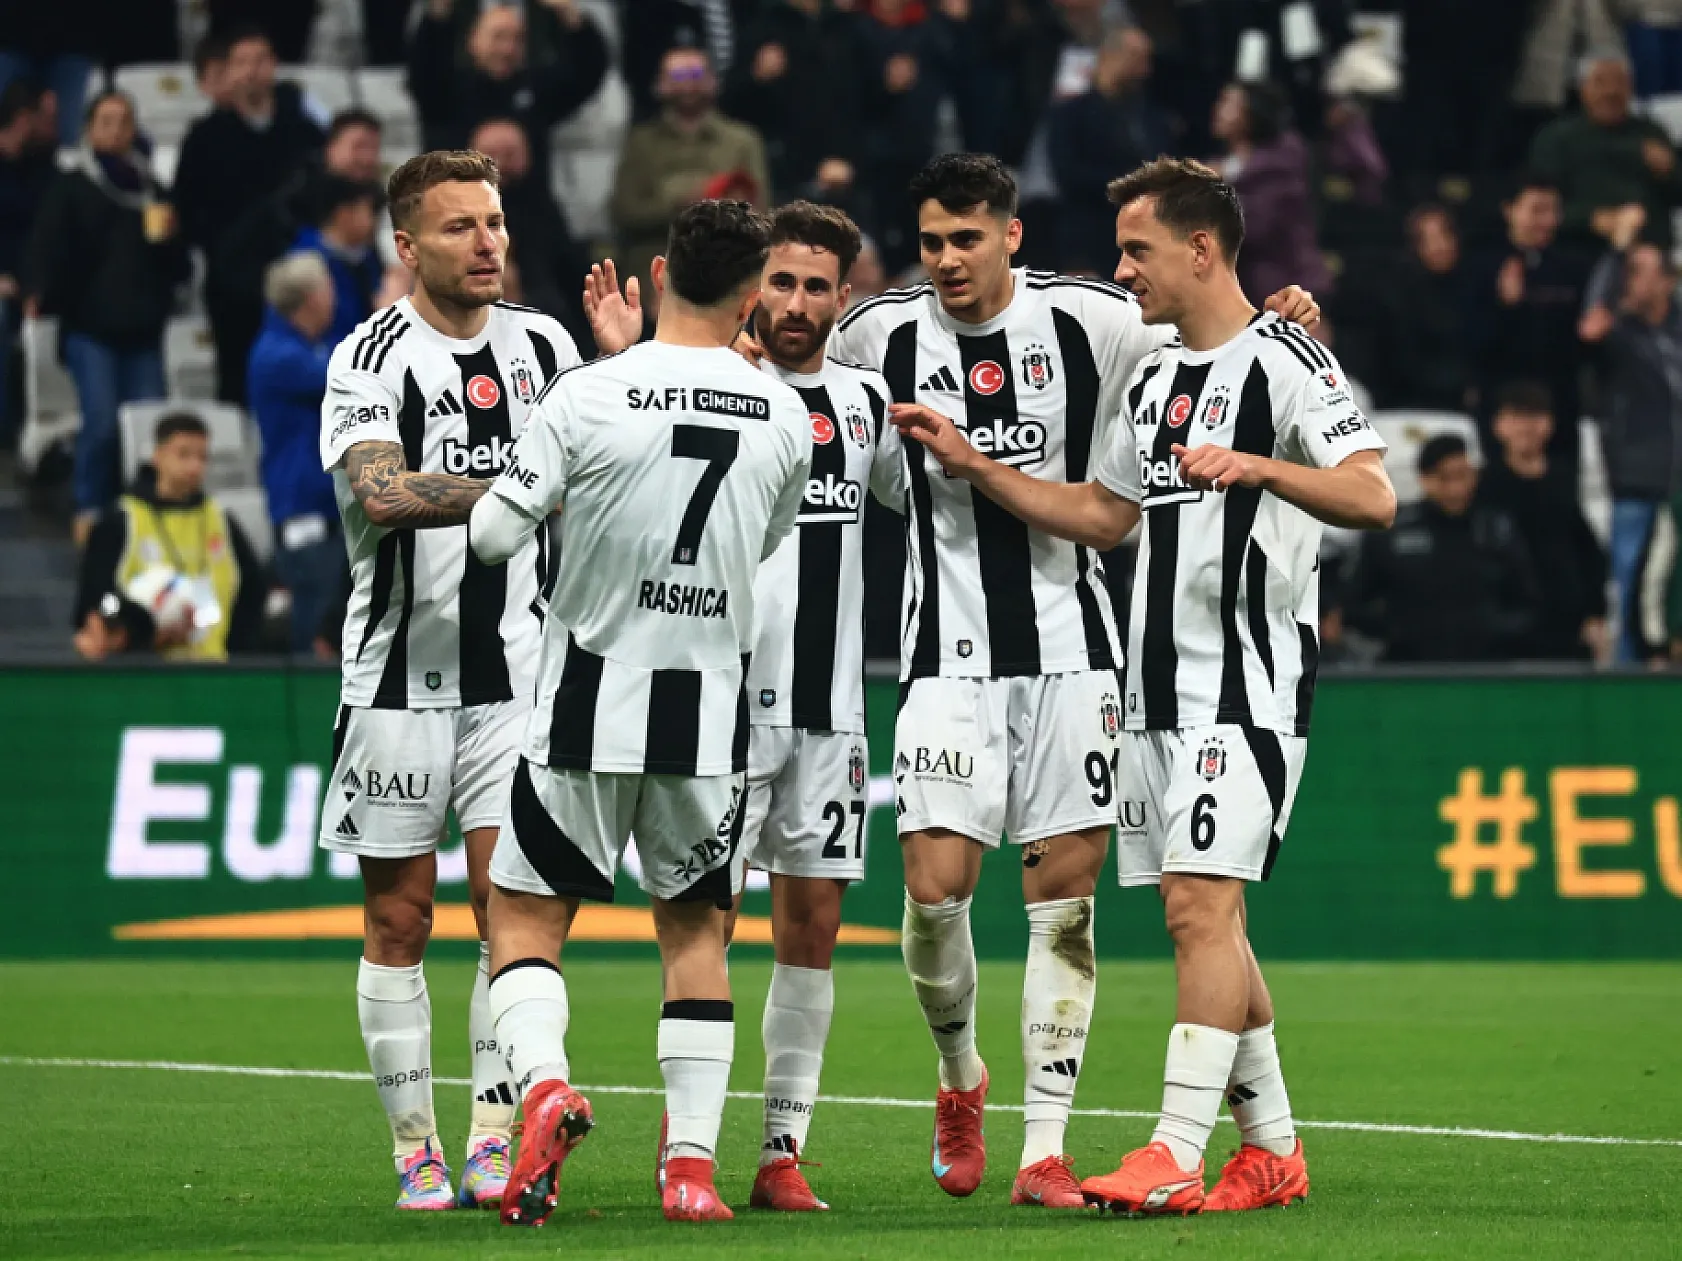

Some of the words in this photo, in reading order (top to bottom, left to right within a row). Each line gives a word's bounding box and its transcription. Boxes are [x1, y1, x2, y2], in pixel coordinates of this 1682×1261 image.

[953, 417, 1046, 453] eko
[443, 436, 515, 476] bek
[1139, 450, 1190, 489] bek
[671, 424, 740, 567] 7
[803, 473, 861, 511] eko
[637, 579, 729, 620] RASHICA
[914, 746, 974, 778] BAU
[366, 769, 431, 800] BAU
[821, 800, 865, 859] 27
[1190, 793, 1218, 852] 6
[1029, 1022, 1087, 1040] papa
